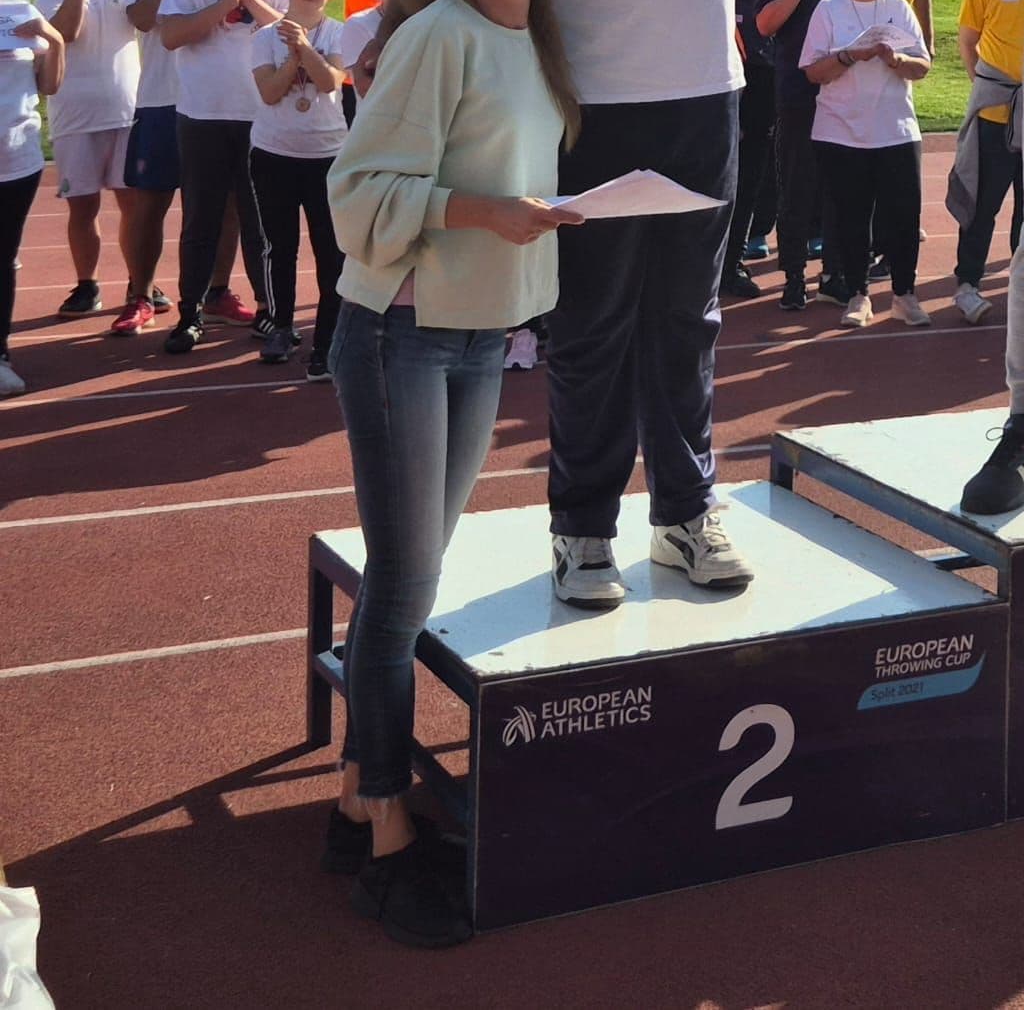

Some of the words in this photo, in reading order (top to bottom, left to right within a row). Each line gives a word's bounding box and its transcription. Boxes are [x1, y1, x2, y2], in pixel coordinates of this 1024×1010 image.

[874, 657, 942, 679] THROWING
[945, 652, 971, 666] CUP
[875, 634, 974, 665] EUROPEAN
[542, 685, 652, 719] EUROPEAN
[871, 687, 896, 702] Split
[898, 682, 924, 695] 2021
[540, 705, 651, 739] ATHLETICS
[715, 703, 796, 830] 2
